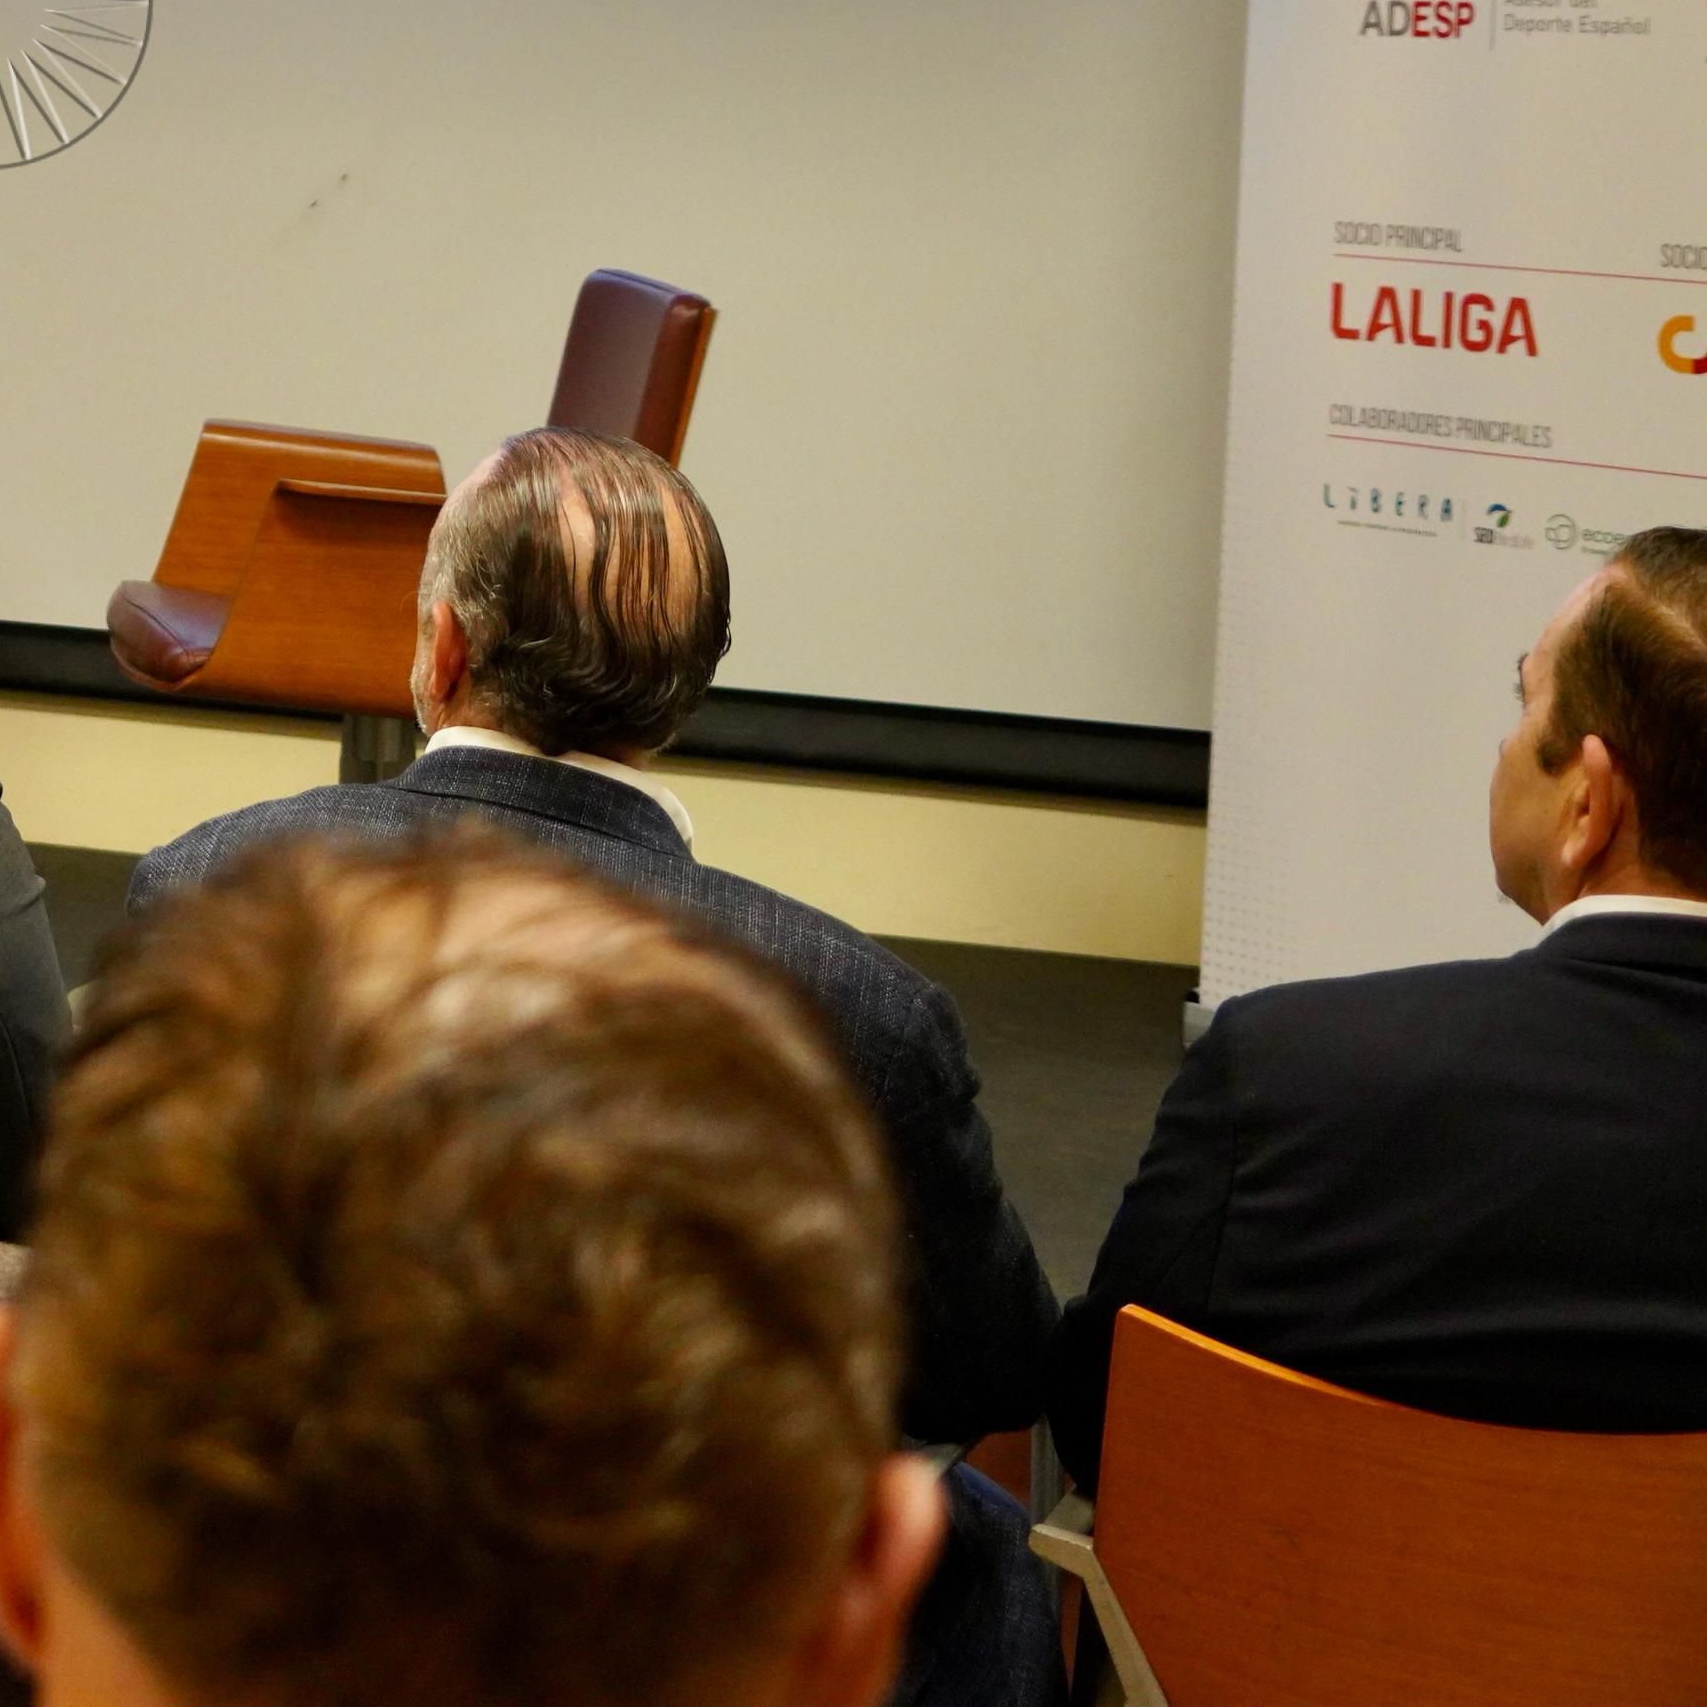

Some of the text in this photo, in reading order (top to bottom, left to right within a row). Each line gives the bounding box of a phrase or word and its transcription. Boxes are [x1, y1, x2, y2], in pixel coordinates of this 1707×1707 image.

[1359, 0, 1475, 40] ADESP
[1503, 13, 1652, 38] Deporte Español
[1334, 221, 1464, 254] SOCIO PRINCIPAL
[1330, 281, 1539, 358] LALIGA
[1329, 402, 1554, 449] COLABORADORES PRINCIPALES
